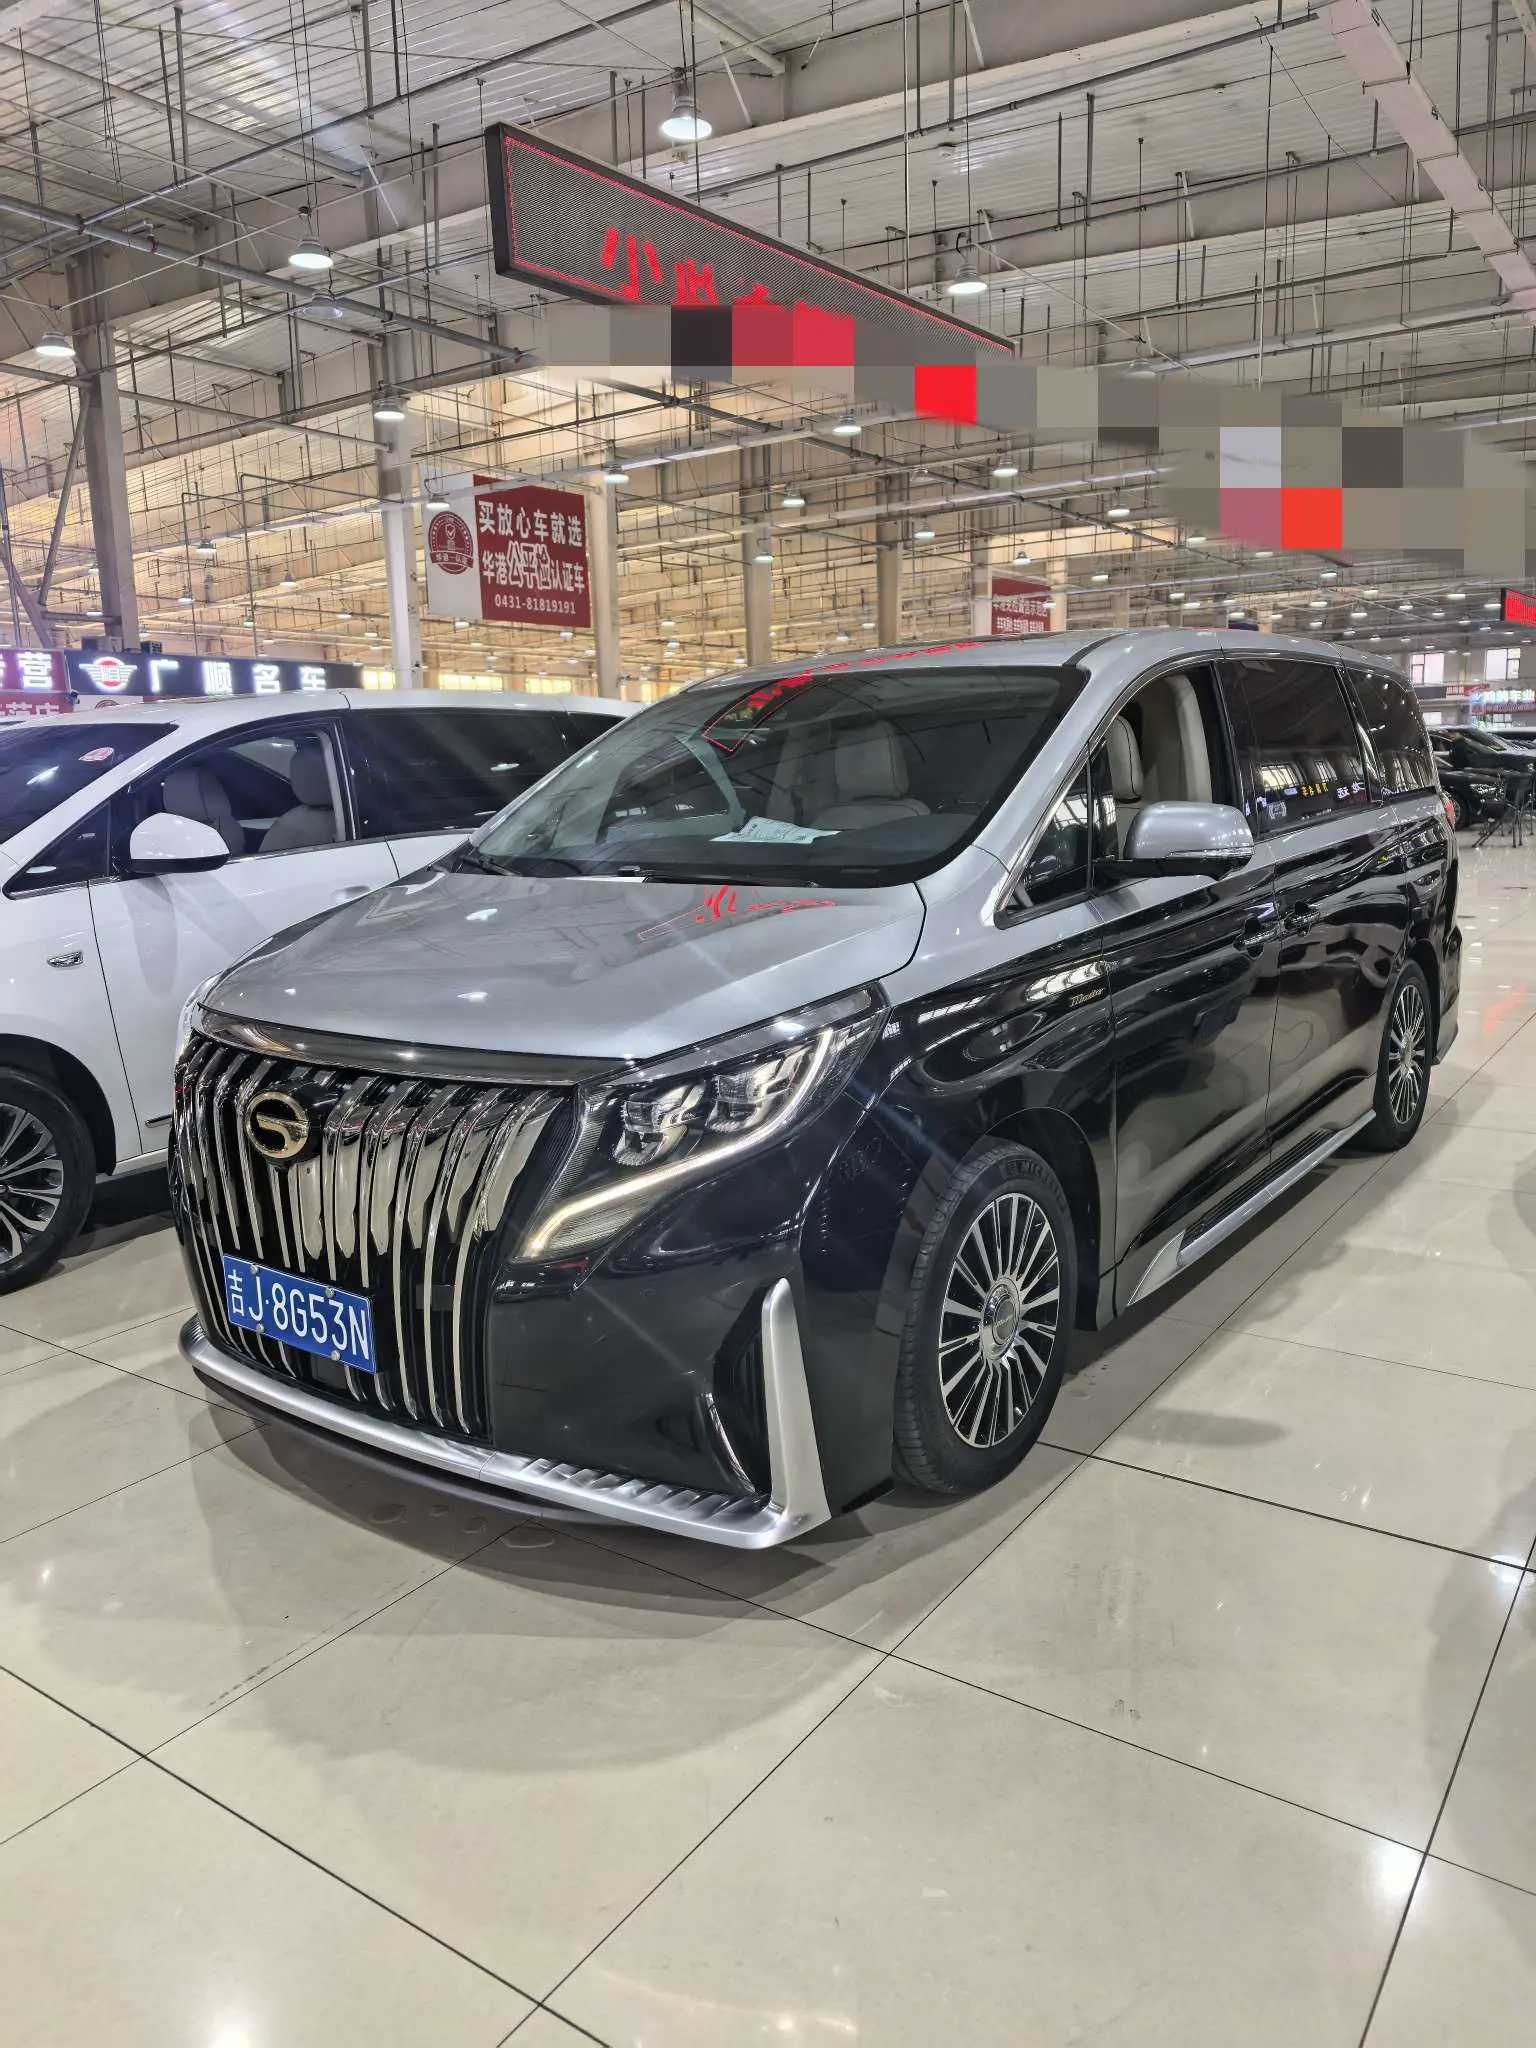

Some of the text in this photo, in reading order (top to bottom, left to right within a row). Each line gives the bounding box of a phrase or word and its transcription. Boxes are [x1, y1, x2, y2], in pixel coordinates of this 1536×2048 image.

[478, 500, 583, 547] 买放心车就选
[494, 594, 576, 614] 0431-81819191
[149, 658, 327, 694] 广顺名车
